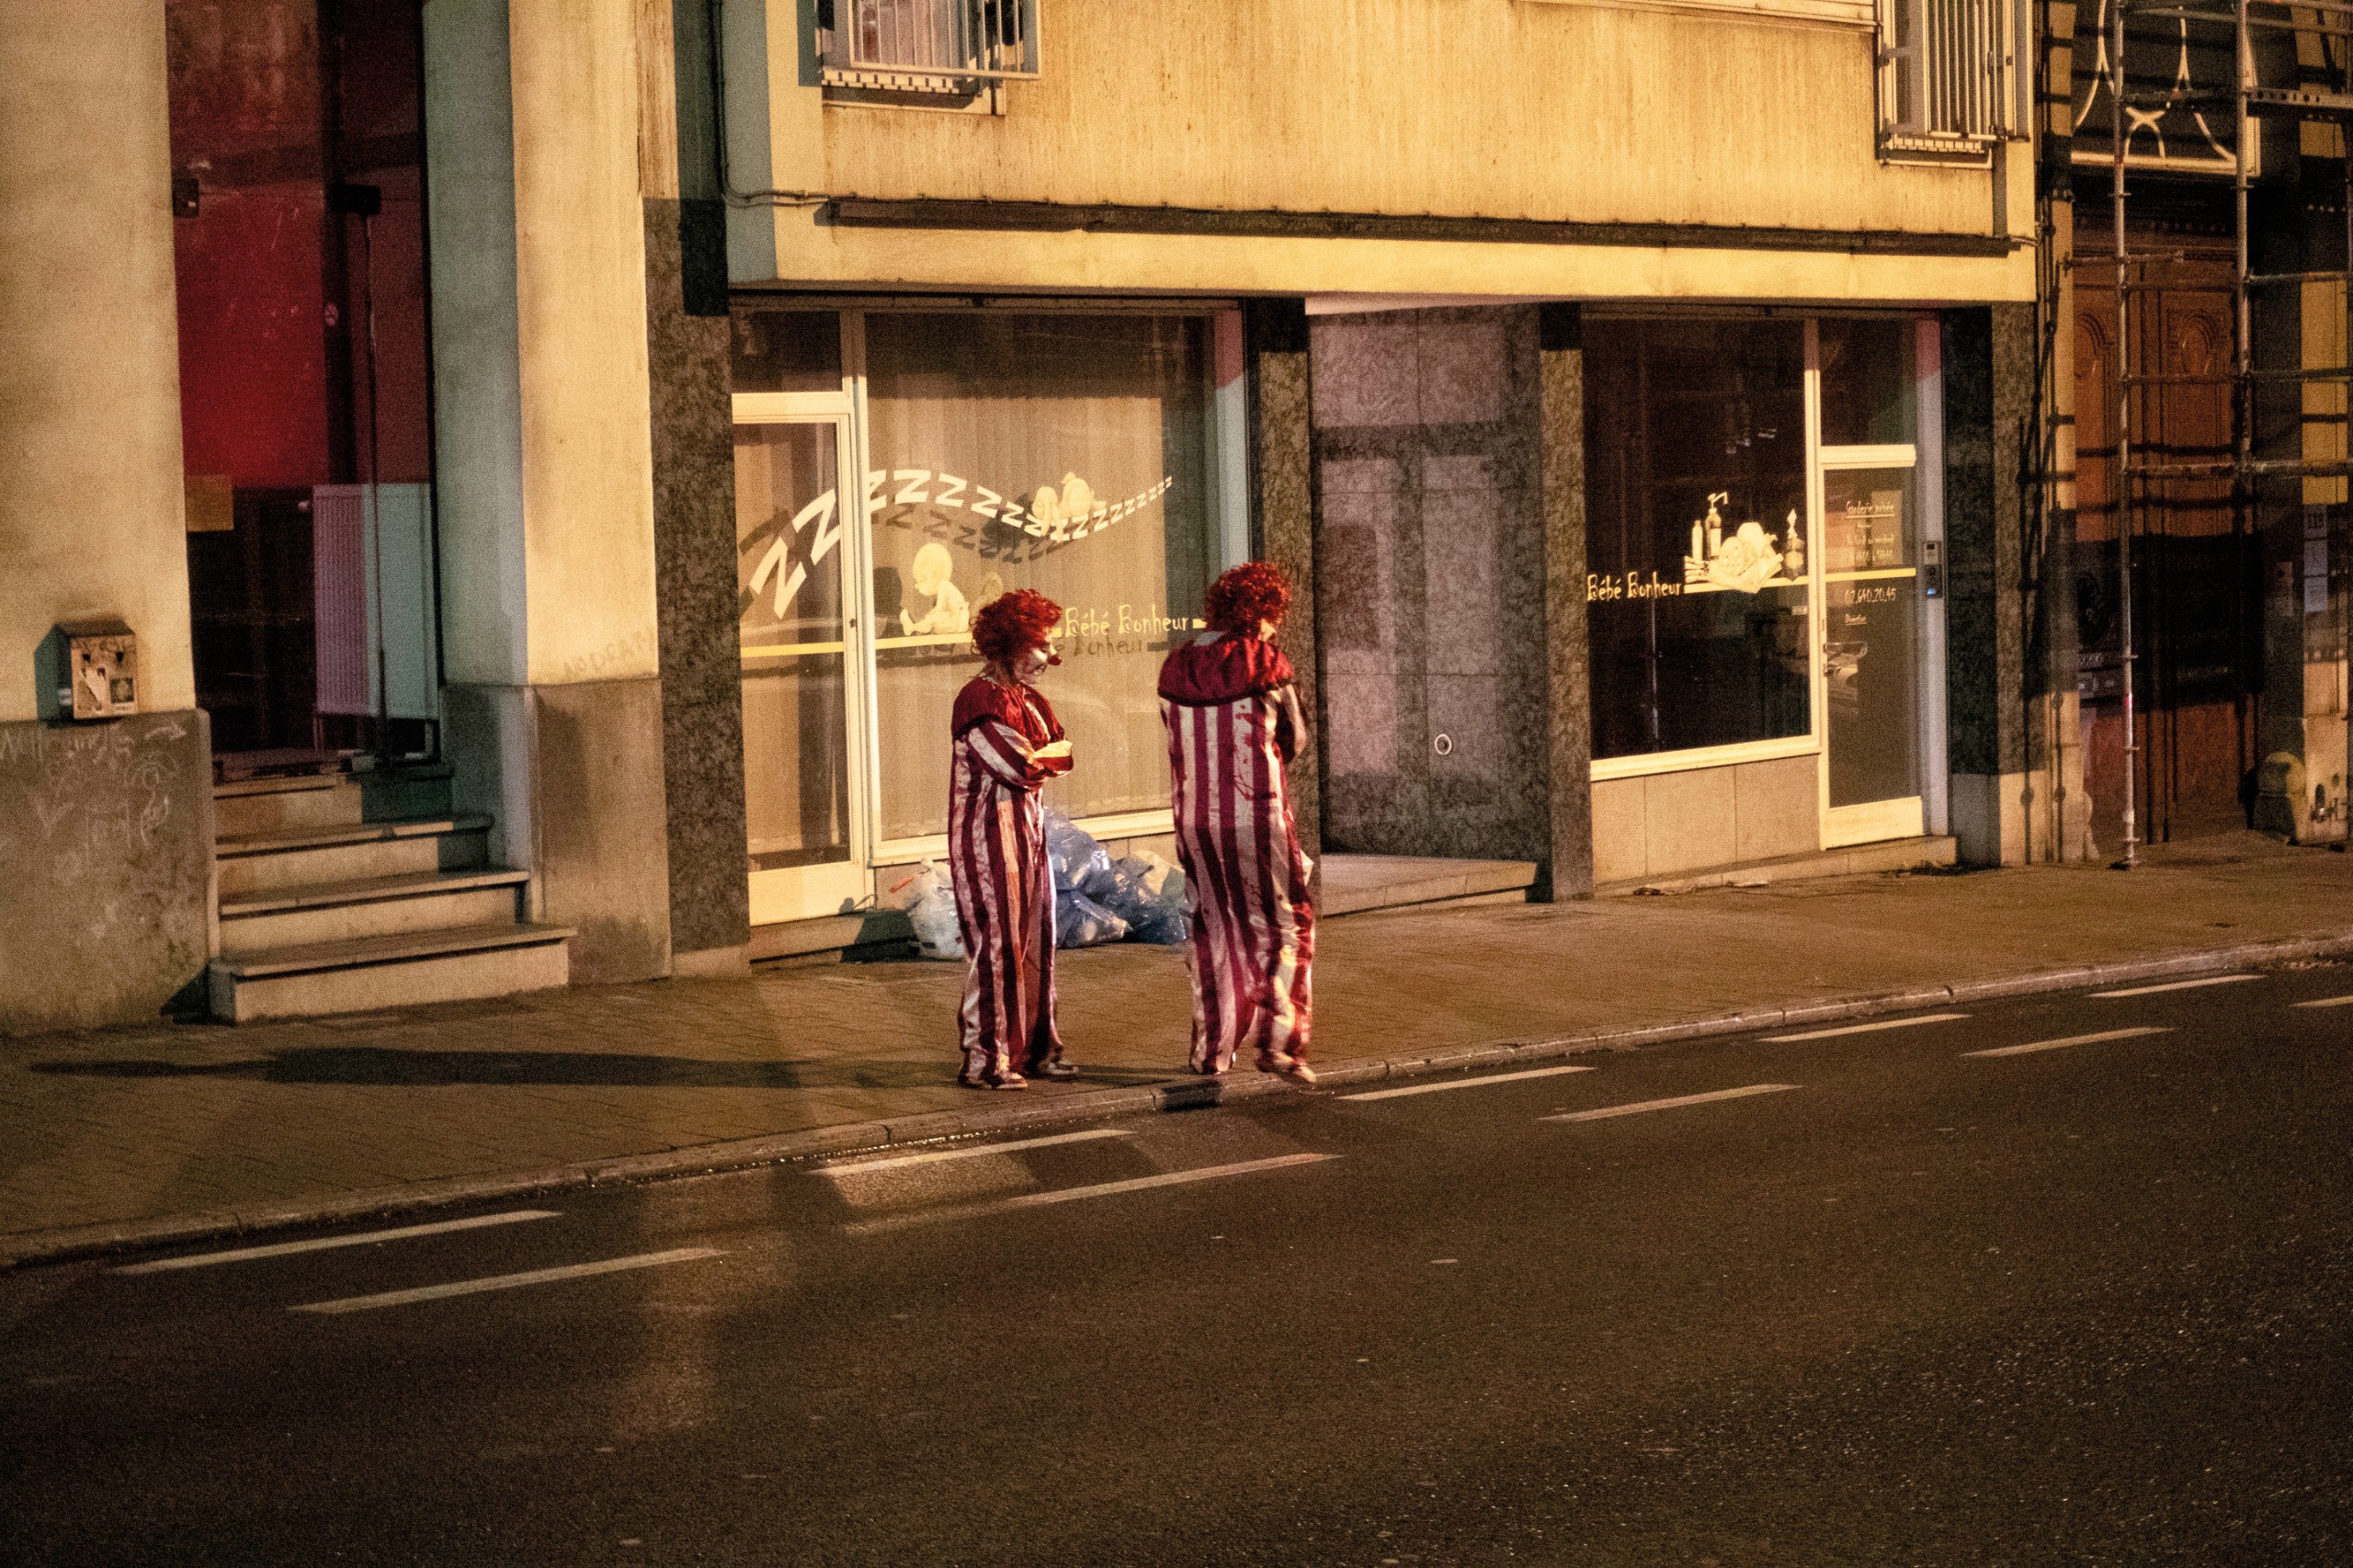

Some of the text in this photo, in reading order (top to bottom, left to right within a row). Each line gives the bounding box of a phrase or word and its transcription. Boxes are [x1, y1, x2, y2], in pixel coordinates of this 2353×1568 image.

[1587, 571, 1682, 602] Bébé Bonheur
[1065, 604, 1189, 638] Bébé Bonheur
